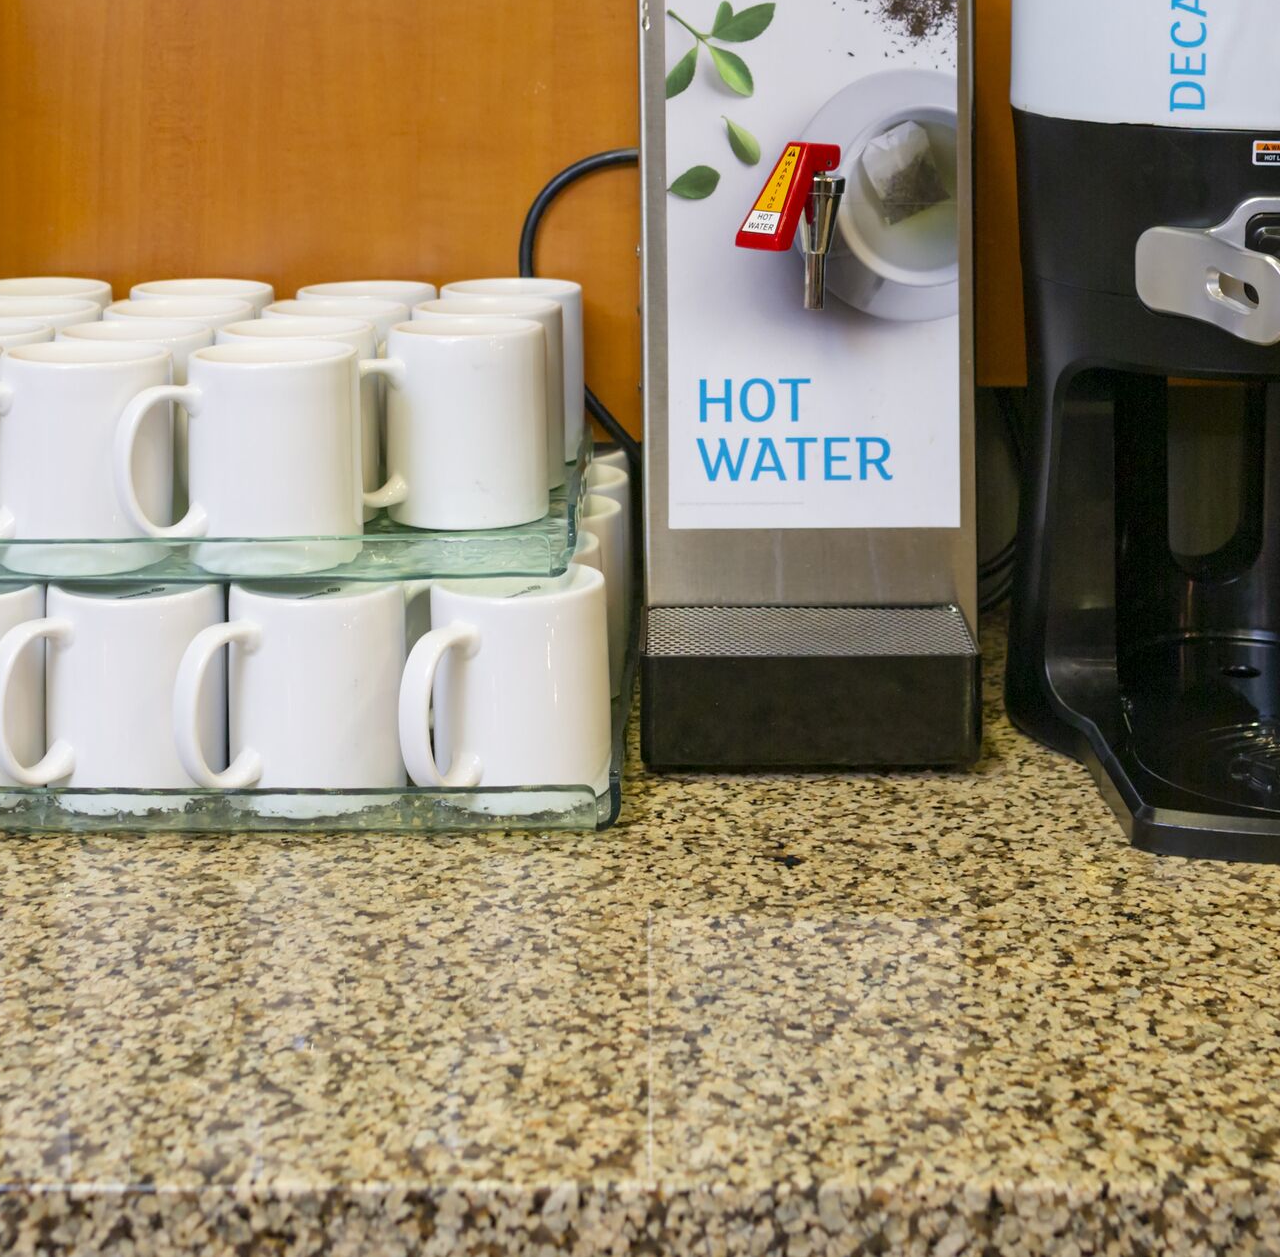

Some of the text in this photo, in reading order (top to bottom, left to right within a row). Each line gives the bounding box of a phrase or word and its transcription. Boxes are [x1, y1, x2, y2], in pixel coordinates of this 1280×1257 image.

[767, 160, 793, 209] WARNING
[748, 222, 774, 232] WATER
[757, 212, 773, 221] HOT
[698, 377, 812, 424] HOT
[696, 435, 895, 482] WATER
